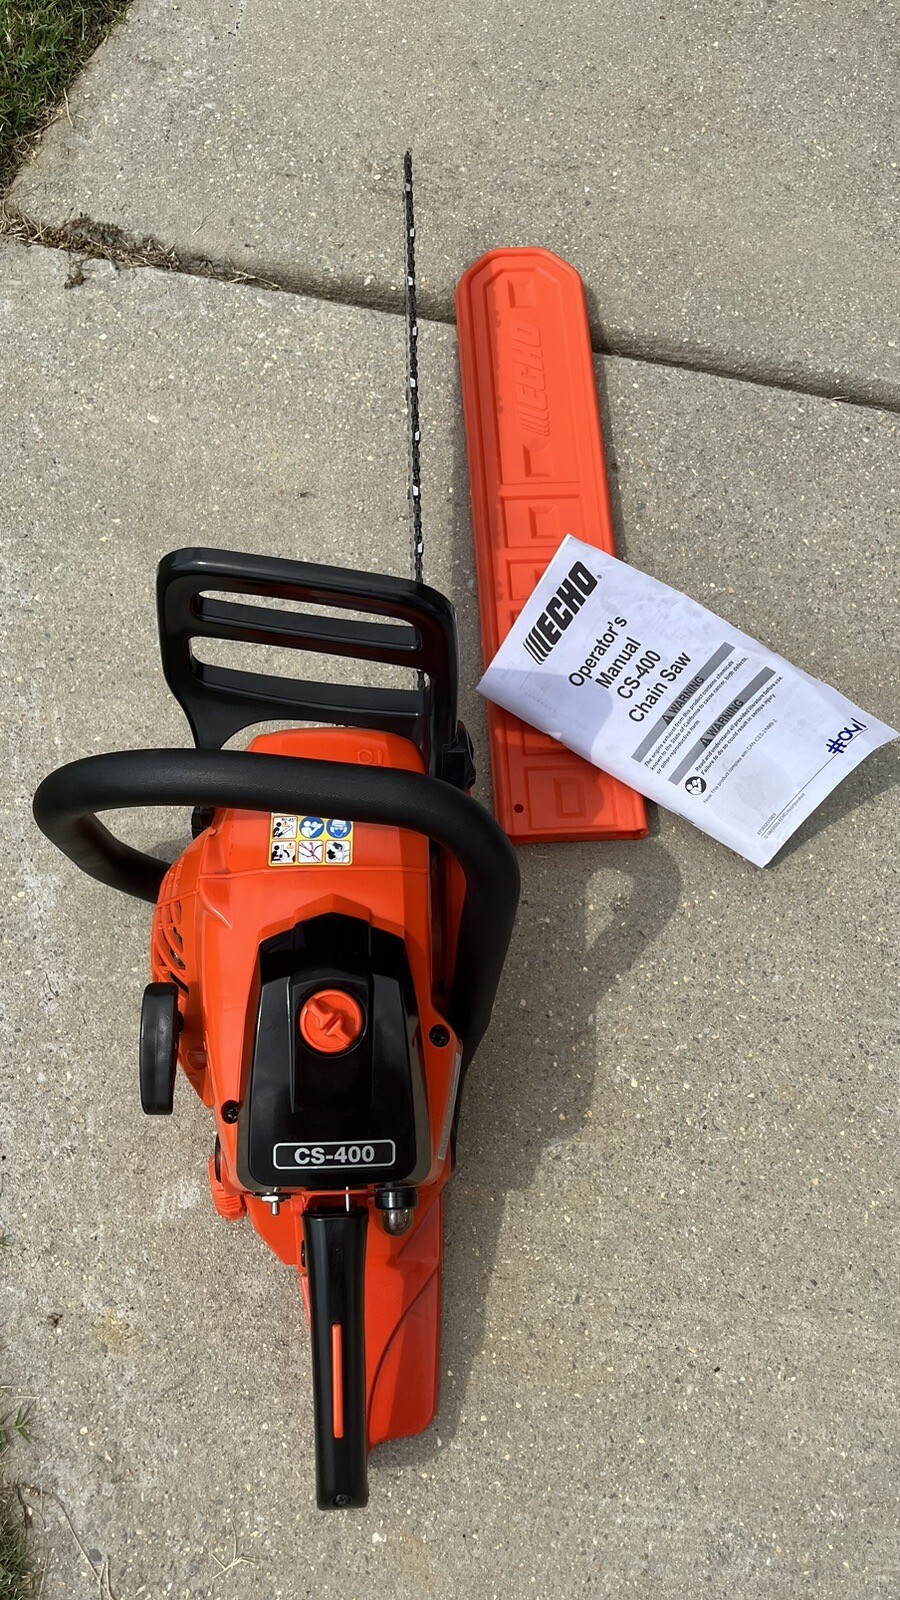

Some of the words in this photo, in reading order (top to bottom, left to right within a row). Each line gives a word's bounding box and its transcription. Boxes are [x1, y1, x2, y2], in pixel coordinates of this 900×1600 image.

[511, 319, 547, 412] ECHO
[536, 561, 598, 646] ECHO
[568, 617, 628, 687] Operator's
[595, 637, 641, 689] Manual
[616, 650, 661, 699] CS-400
[628, 682, 669, 722] Chain
[659, 652, 691, 683] Saw
[644, 757, 652, 766] The
[650, 745, 663, 759] engine
[661, 725, 676, 743] exhaust
[674, 716, 683, 727] from
[681, 708, 690, 717] this
[689, 693, 704, 710] product
[702, 678, 716, 695] contains
[716, 659, 733, 680] chemicals
[649, 755, 663, 770] known
[664, 742, 672, 751] the
[670, 731, 681, 743] State
[682, 707, 701, 727] California
[703, 692, 714, 704] cause
[724, 669, 734, 680] birth
[669, 676, 704, 715] WARNING
[694, 759, 706, 771] Read
[703, 751, 713, 760] and
[709, 729, 731, 753] understand
[732, 708, 750, 727] provided
[762, 681, 776, 696] before
[707, 699, 744, 738] WARNING
[659, 755, 670, 768] other
[668, 729, 691, 757] reproductive
[699, 758, 715, 775] Failure
[726, 730, 739, 744] could
[736, 719, 748, 733] result
[750, 702, 765, 718] serious
[826, 717, 867, 754] #041
[294, 1145, 375, 1165] CS-400
